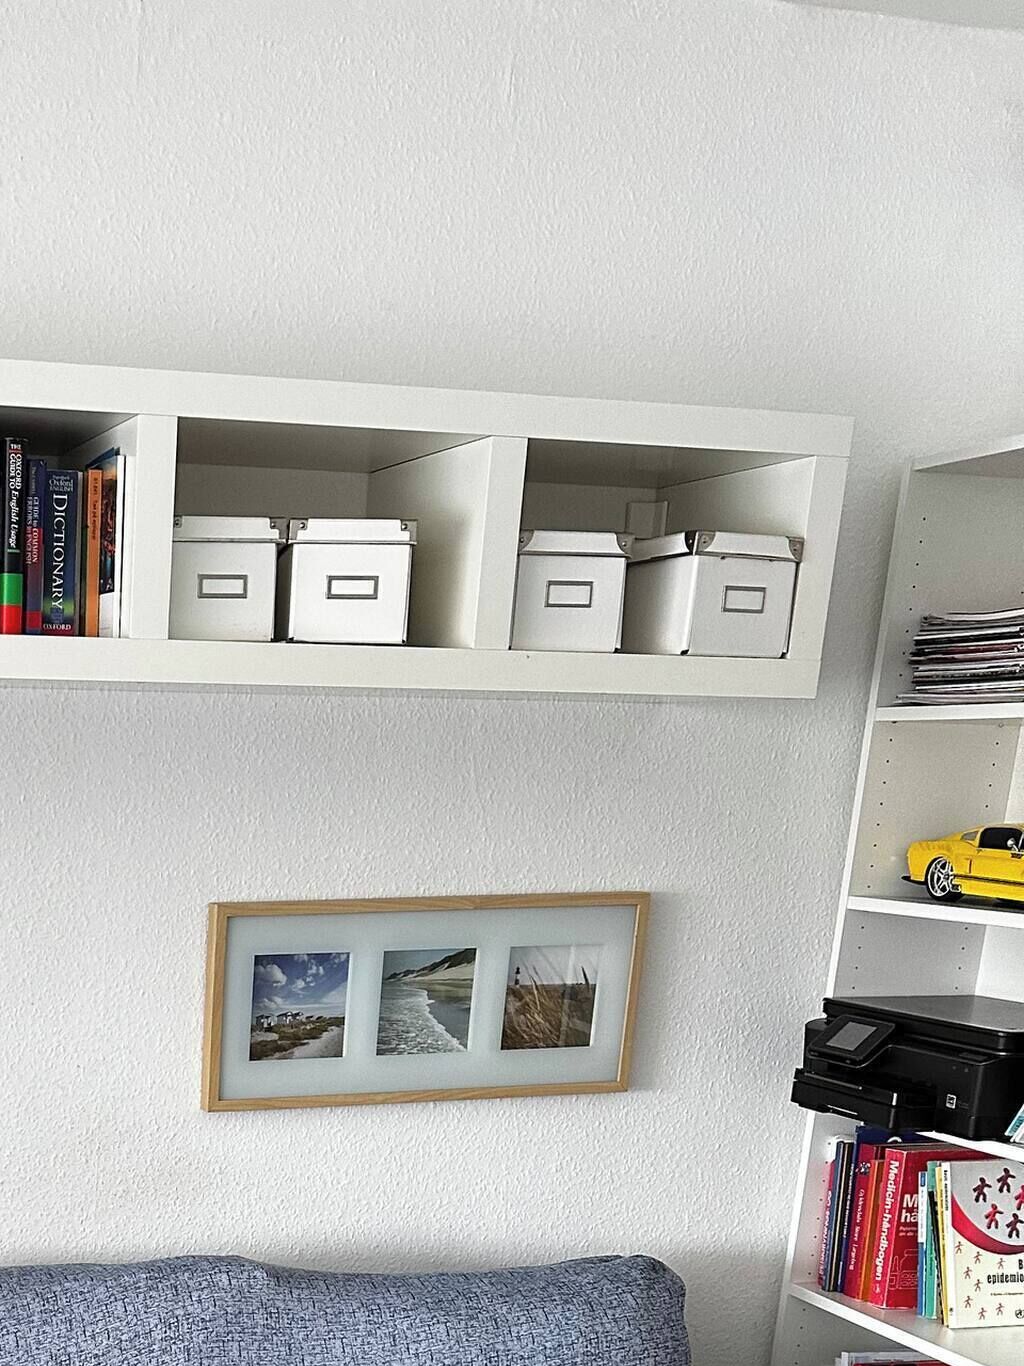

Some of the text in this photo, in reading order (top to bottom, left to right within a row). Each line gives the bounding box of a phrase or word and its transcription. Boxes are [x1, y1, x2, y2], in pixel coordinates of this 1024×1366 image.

[9, 478, 16, 490] TO
[10, 490, 20, 522] English
[51, 493, 68, 609] DICTIONARY
